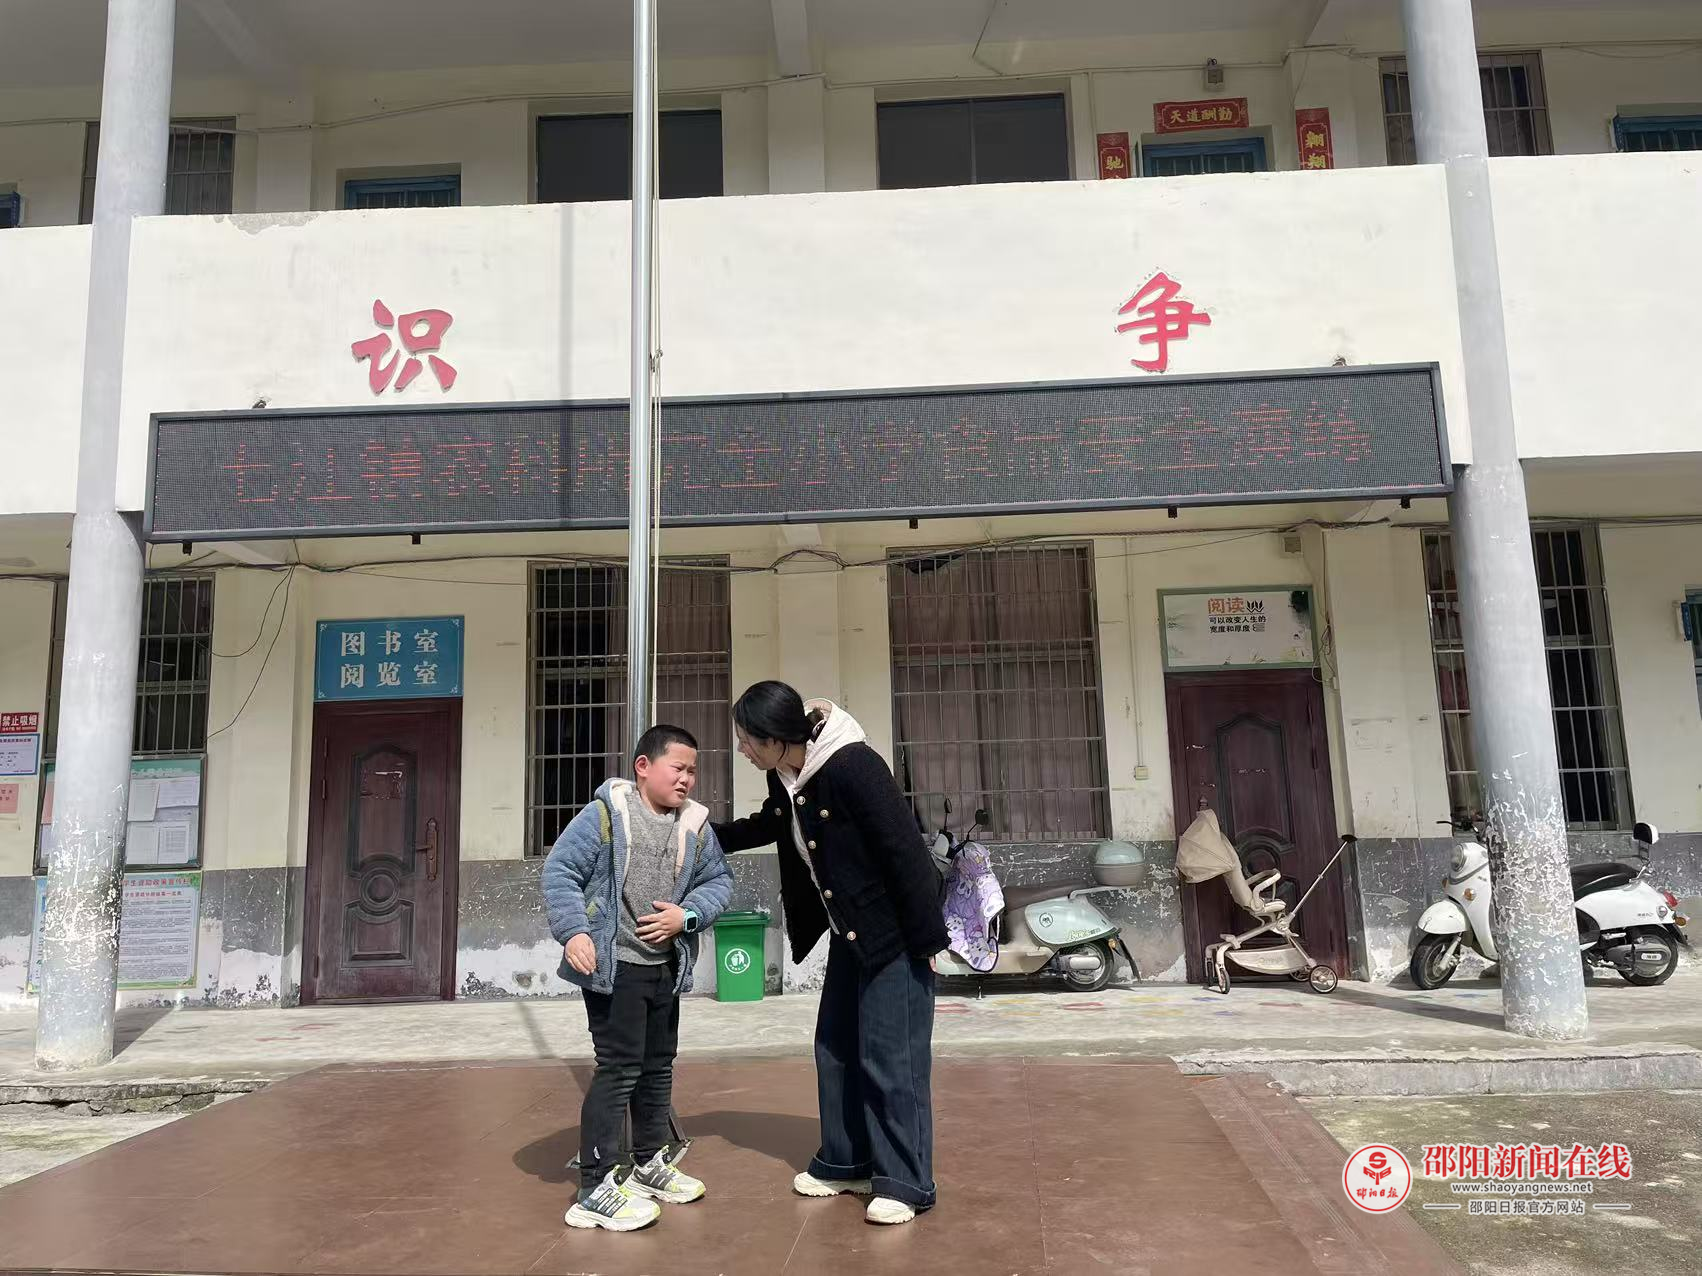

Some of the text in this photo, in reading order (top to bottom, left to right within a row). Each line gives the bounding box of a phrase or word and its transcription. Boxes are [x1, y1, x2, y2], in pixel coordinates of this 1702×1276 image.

[1170, 106, 1233, 124] 天道酬勤
[1117, 272, 1212, 373] 争
[351, 299, 458, 395] 识
[1208, 597, 1245, 614] 阅读
[1209, 615, 1266, 624] 可以改变人生的
[1209, 624, 1250, 634] 宽度和厚度
[340, 628, 439, 657] 图书室
[339, 660, 438, 689] 阅览室
[2, 715, 37, 726] 禁止吸烟
